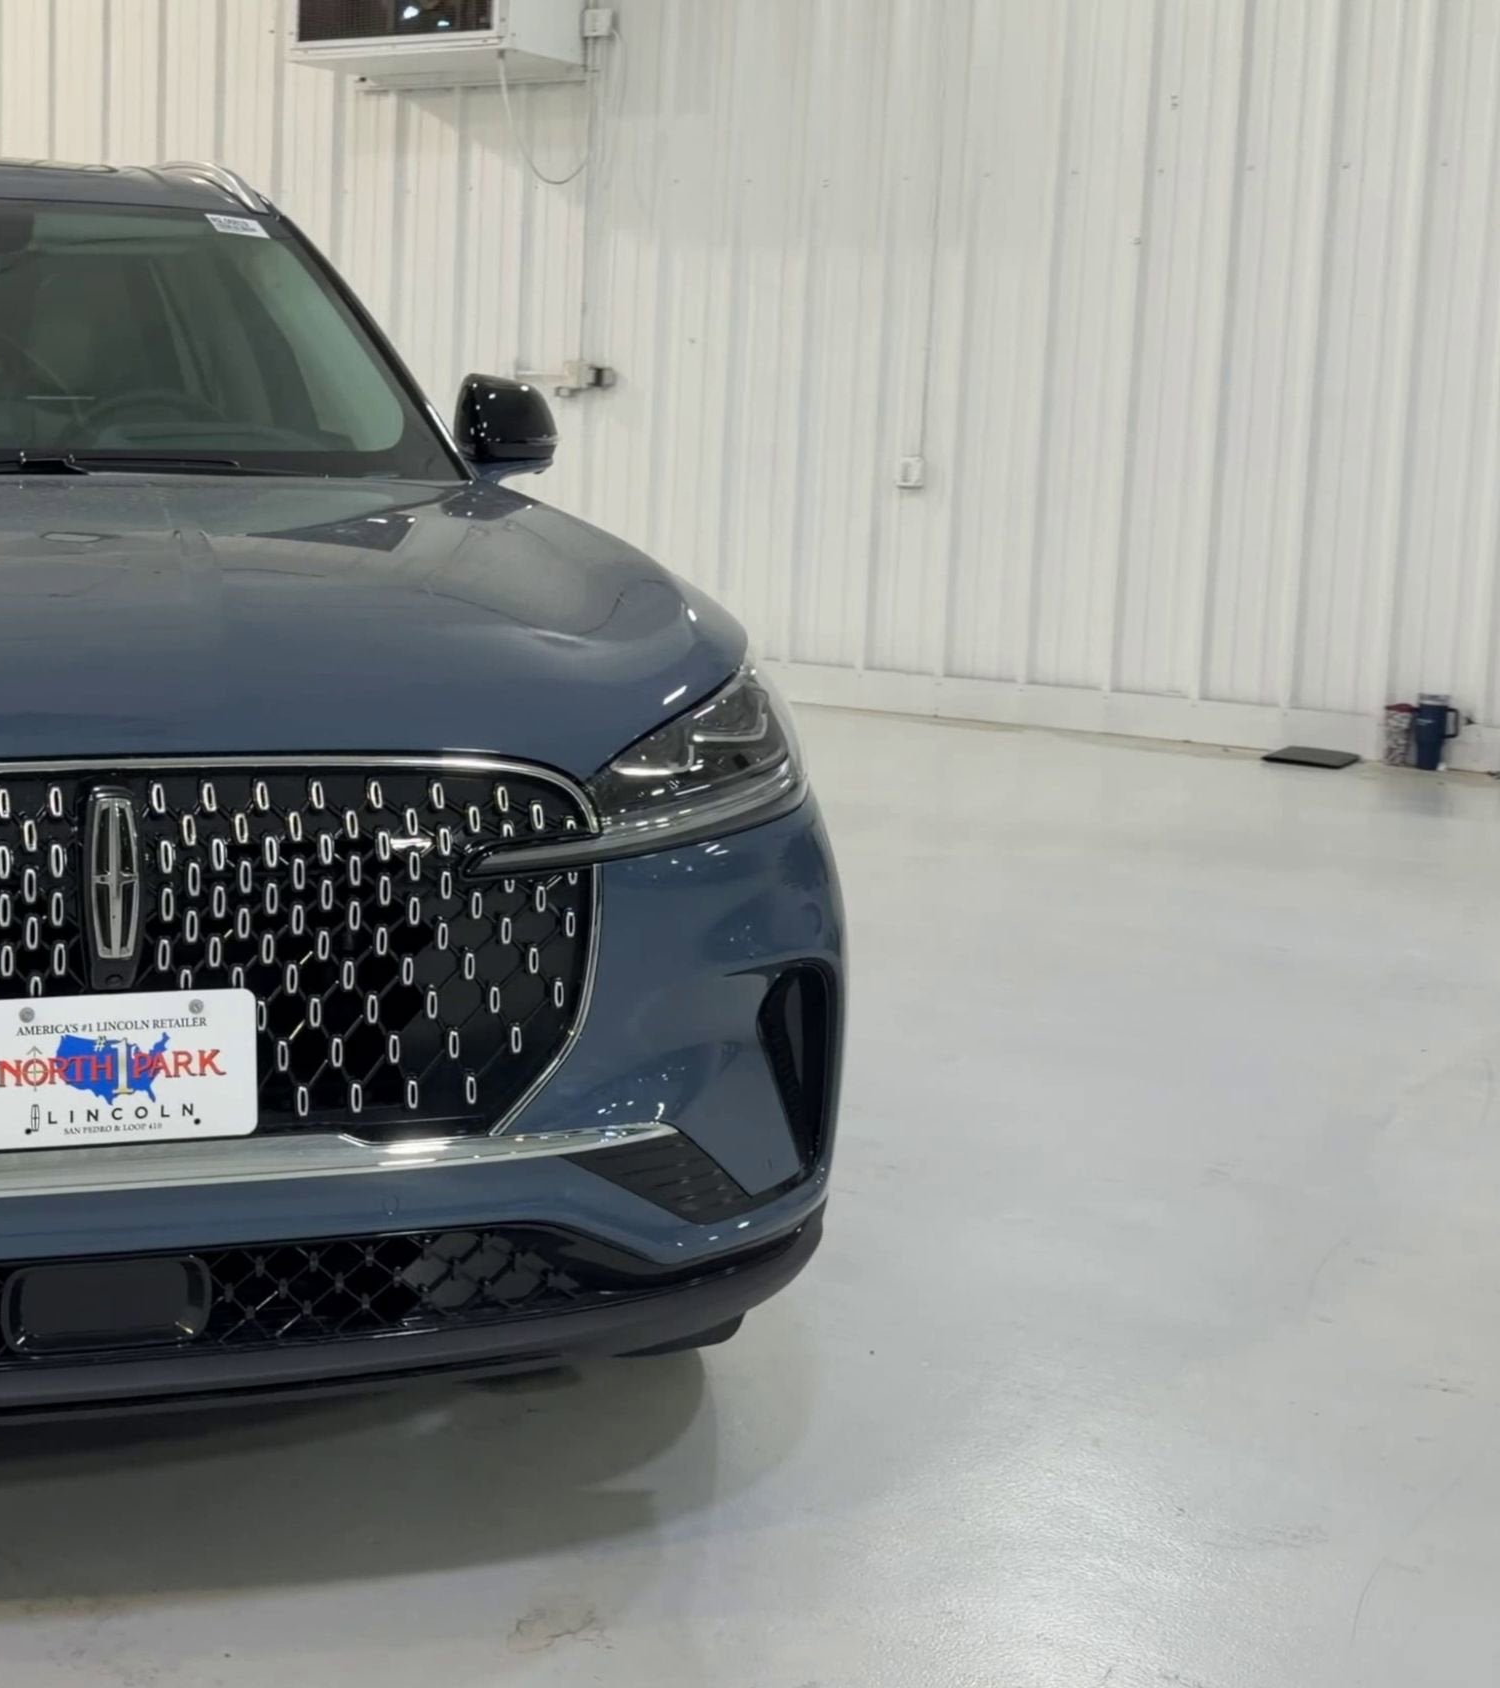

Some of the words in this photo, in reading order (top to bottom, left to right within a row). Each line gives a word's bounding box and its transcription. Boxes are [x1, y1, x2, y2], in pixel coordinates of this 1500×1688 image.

[16, 1024, 78, 1037] AMERICA'S
[81, 1023, 93, 1033] #1
[96, 1019, 150, 1032] LINCOLN
[152, 1017, 207, 1029] RETAILER
[133, 1048, 227, 1079] PARK
[47, 1103, 194, 1125] LINCOLN
[63, 1126, 80, 1135] SAN
[83, 1124, 112, 1134] PEDRO
[114, 1124, 121, 1132] &
[123, 1123, 146, 1132] LOOP
